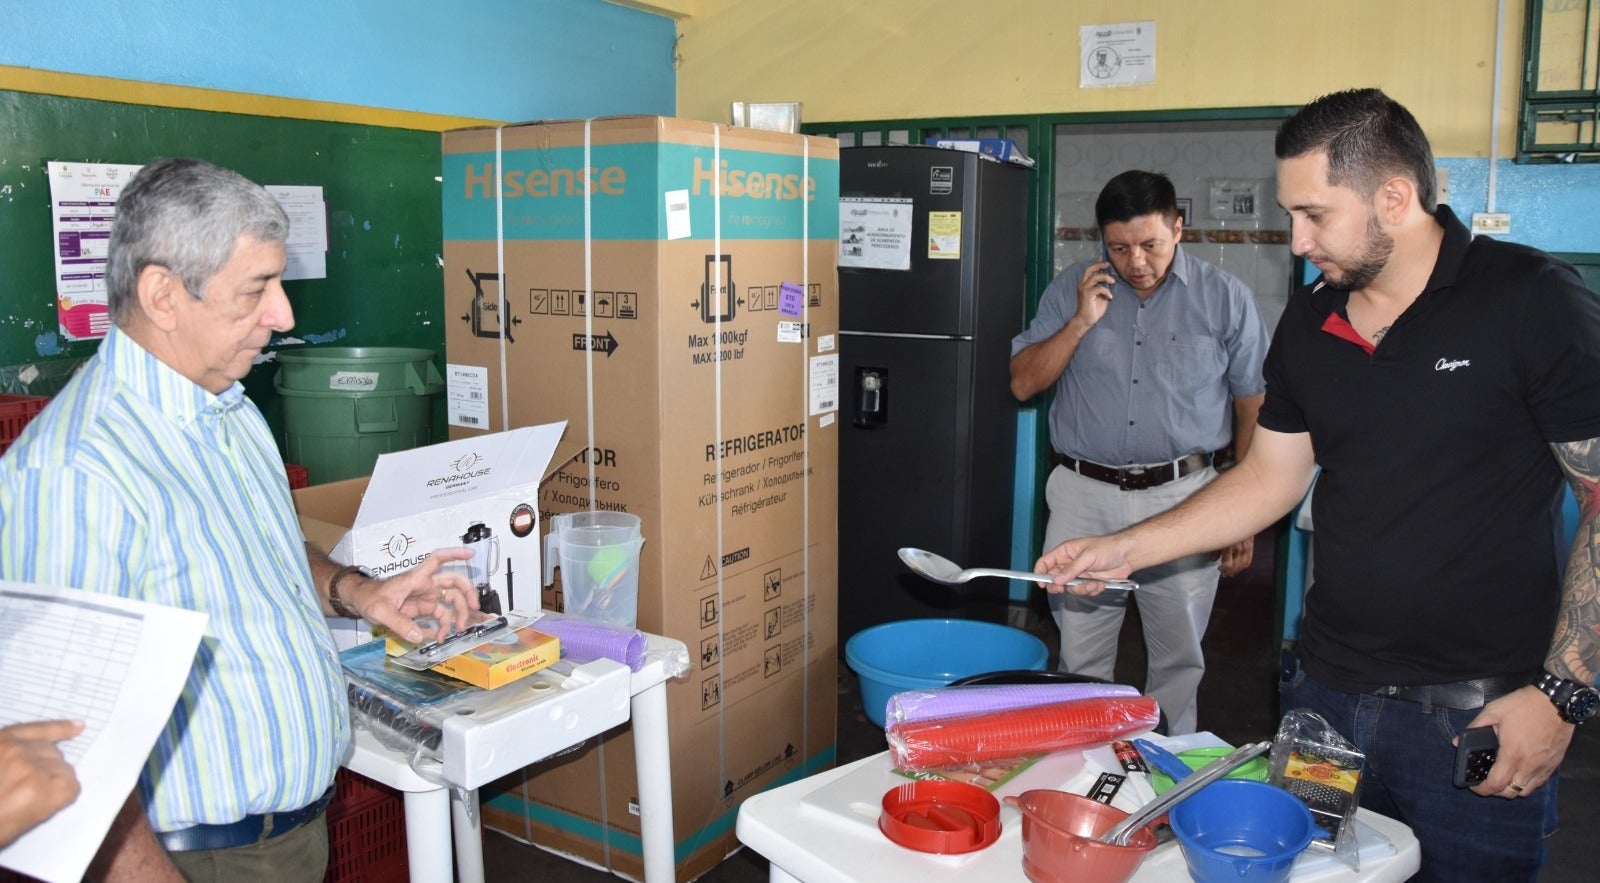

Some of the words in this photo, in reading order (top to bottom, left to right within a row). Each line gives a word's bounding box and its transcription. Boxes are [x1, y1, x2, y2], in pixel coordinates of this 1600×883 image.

[691, 157, 816, 201] Hisense
[95, 188, 111, 197] PAE
[482, 302, 498, 312] Side
[623, 294, 629, 304] 3
[688, 334, 709, 348] Max
[692, 352, 712, 365] MAX
[427, 467, 492, 487] RENAHOUSE
[703, 462, 760, 486] Reigerador
[698, 482, 755, 508] Kühschrank
[506, 653, 539, 673] Electronic
